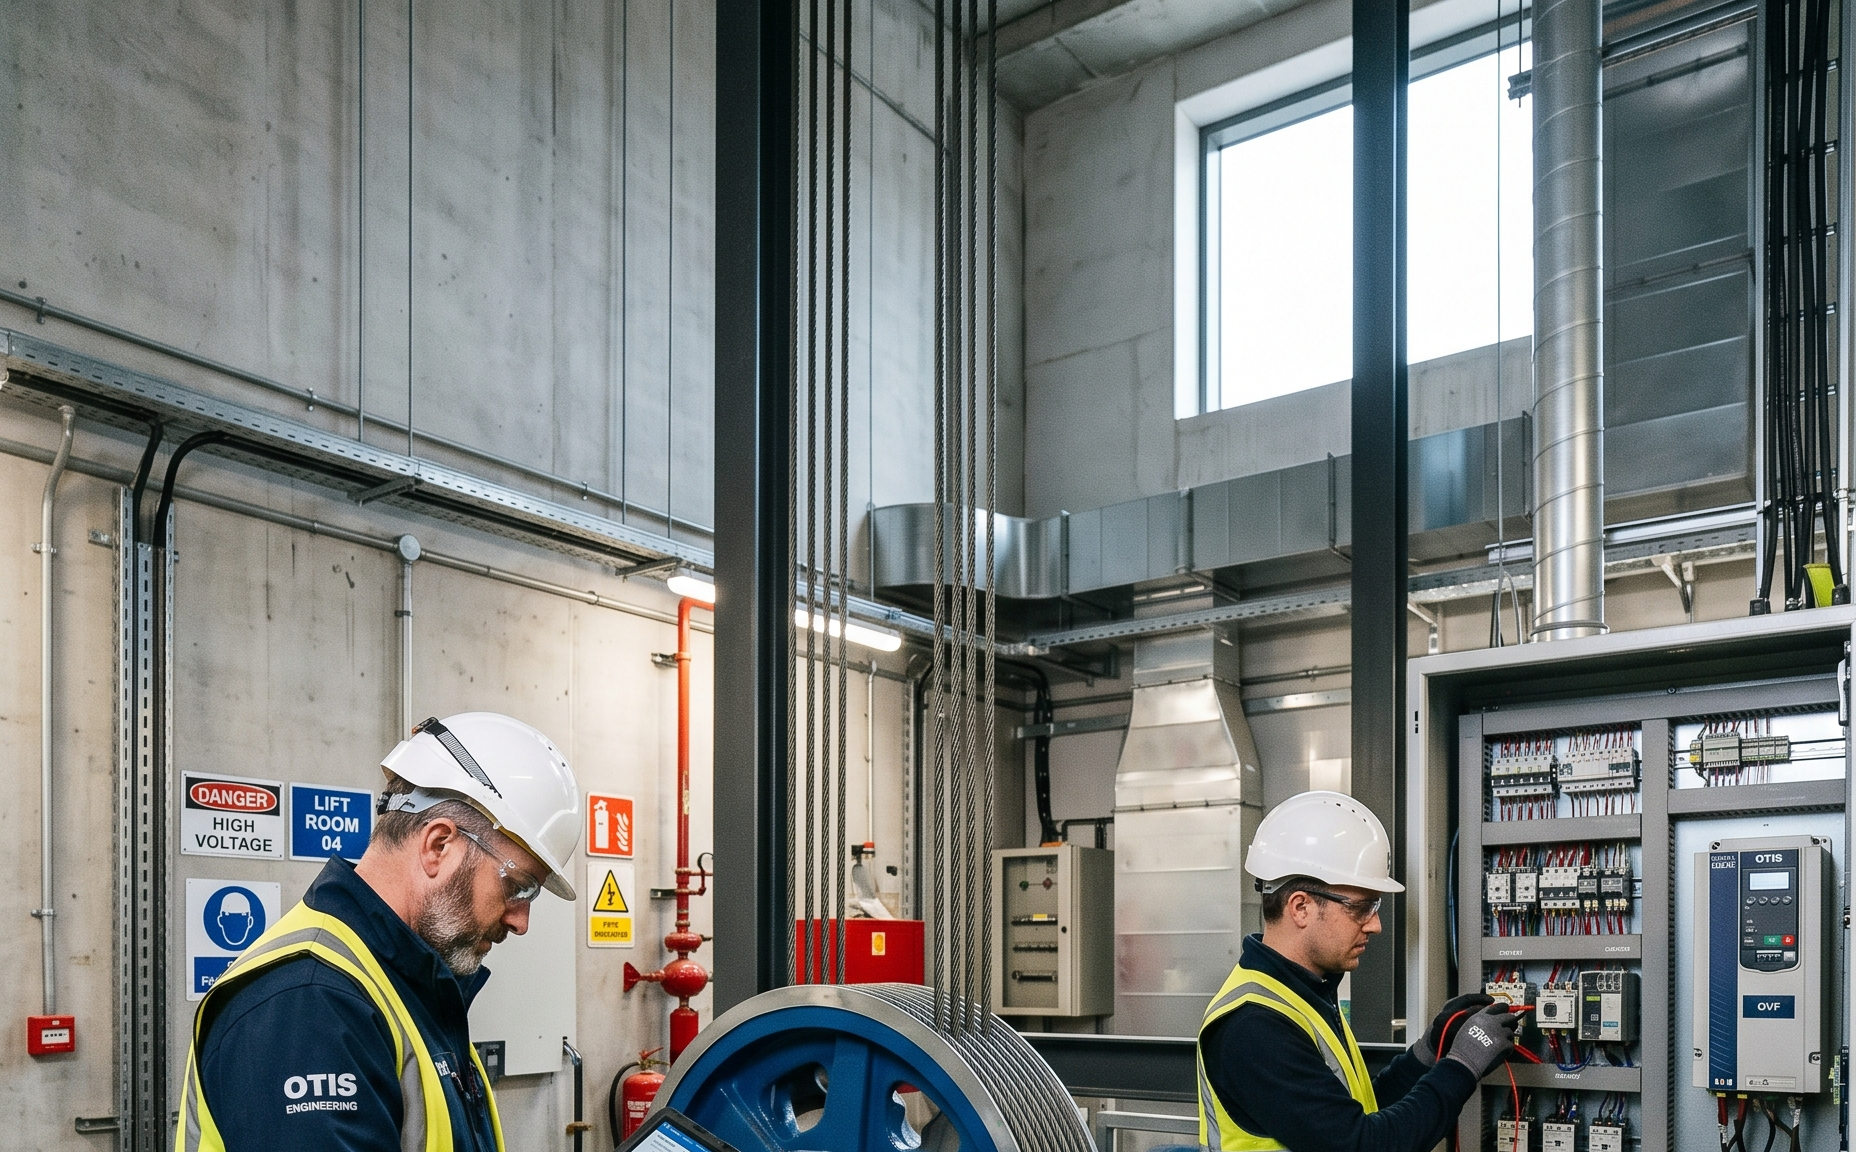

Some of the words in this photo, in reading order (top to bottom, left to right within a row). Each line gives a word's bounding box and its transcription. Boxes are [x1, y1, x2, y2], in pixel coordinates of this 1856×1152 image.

[198, 787, 268, 808] DANGER
[314, 795, 351, 813] LIFT
[213, 817, 255, 833] HIGH
[305, 814, 359, 833] ROOM
[195, 834, 273, 852] VOLTAGE
[321, 836, 342, 852] 04
[1755, 854, 1783, 863] OTIS
[1757, 1002, 1781, 1011] OVF
[283, 1073, 358, 1100] OTIS
[286, 1101, 358, 1114] ENGINEERING
